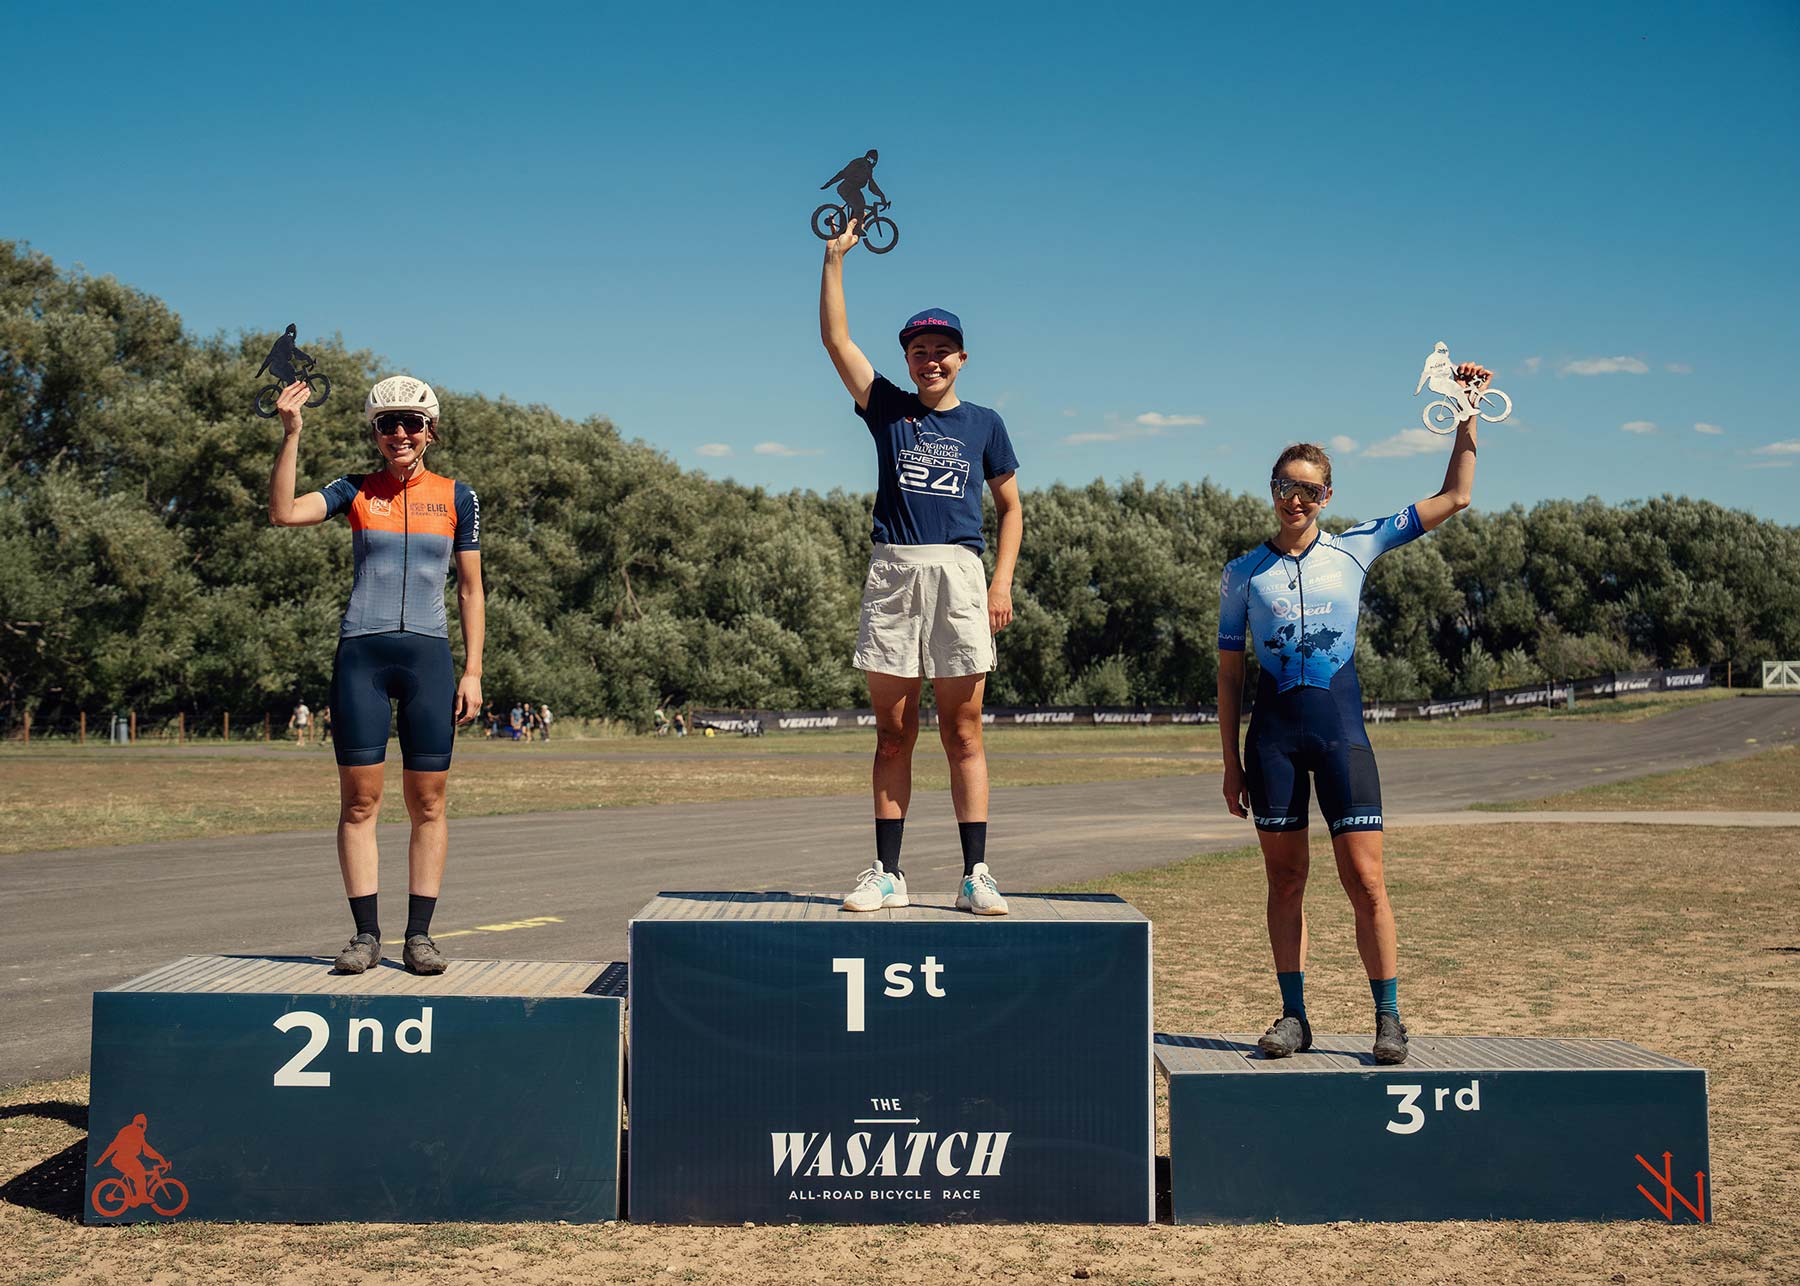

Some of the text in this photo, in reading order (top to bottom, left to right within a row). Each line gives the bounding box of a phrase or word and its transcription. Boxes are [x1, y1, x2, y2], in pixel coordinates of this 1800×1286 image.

[912, 317, 948, 327] The Feed
[904, 444, 959, 458] BLUE RIDGE
[901, 452, 967, 469] TWENTY
[900, 463, 960, 495] 24
[427, 503, 448, 512] ELIEL
[470, 490, 480, 543] VENTUM
[1666, 673, 1705, 687] VENTUM
[1417, 698, 1483, 716] VENTUM
[778, 716, 839, 729] VENTUM
[1014, 712, 1075, 723] VENTUM
[1093, 712, 1153, 723] VENTUM
[1171, 712, 1219, 723] VENTU
[1333, 815, 1382, 830] SRAM
[832, 956, 946, 1032] 1st
[272, 1007, 433, 1087] 2nd
[871, 1098, 902, 1111] THE
[1385, 1080, 1480, 1134] 3rd
[770, 1131, 1013, 1177] WASATCH
[788, 1190, 981, 1200] ALL-ROAD BICYCLE RACE
